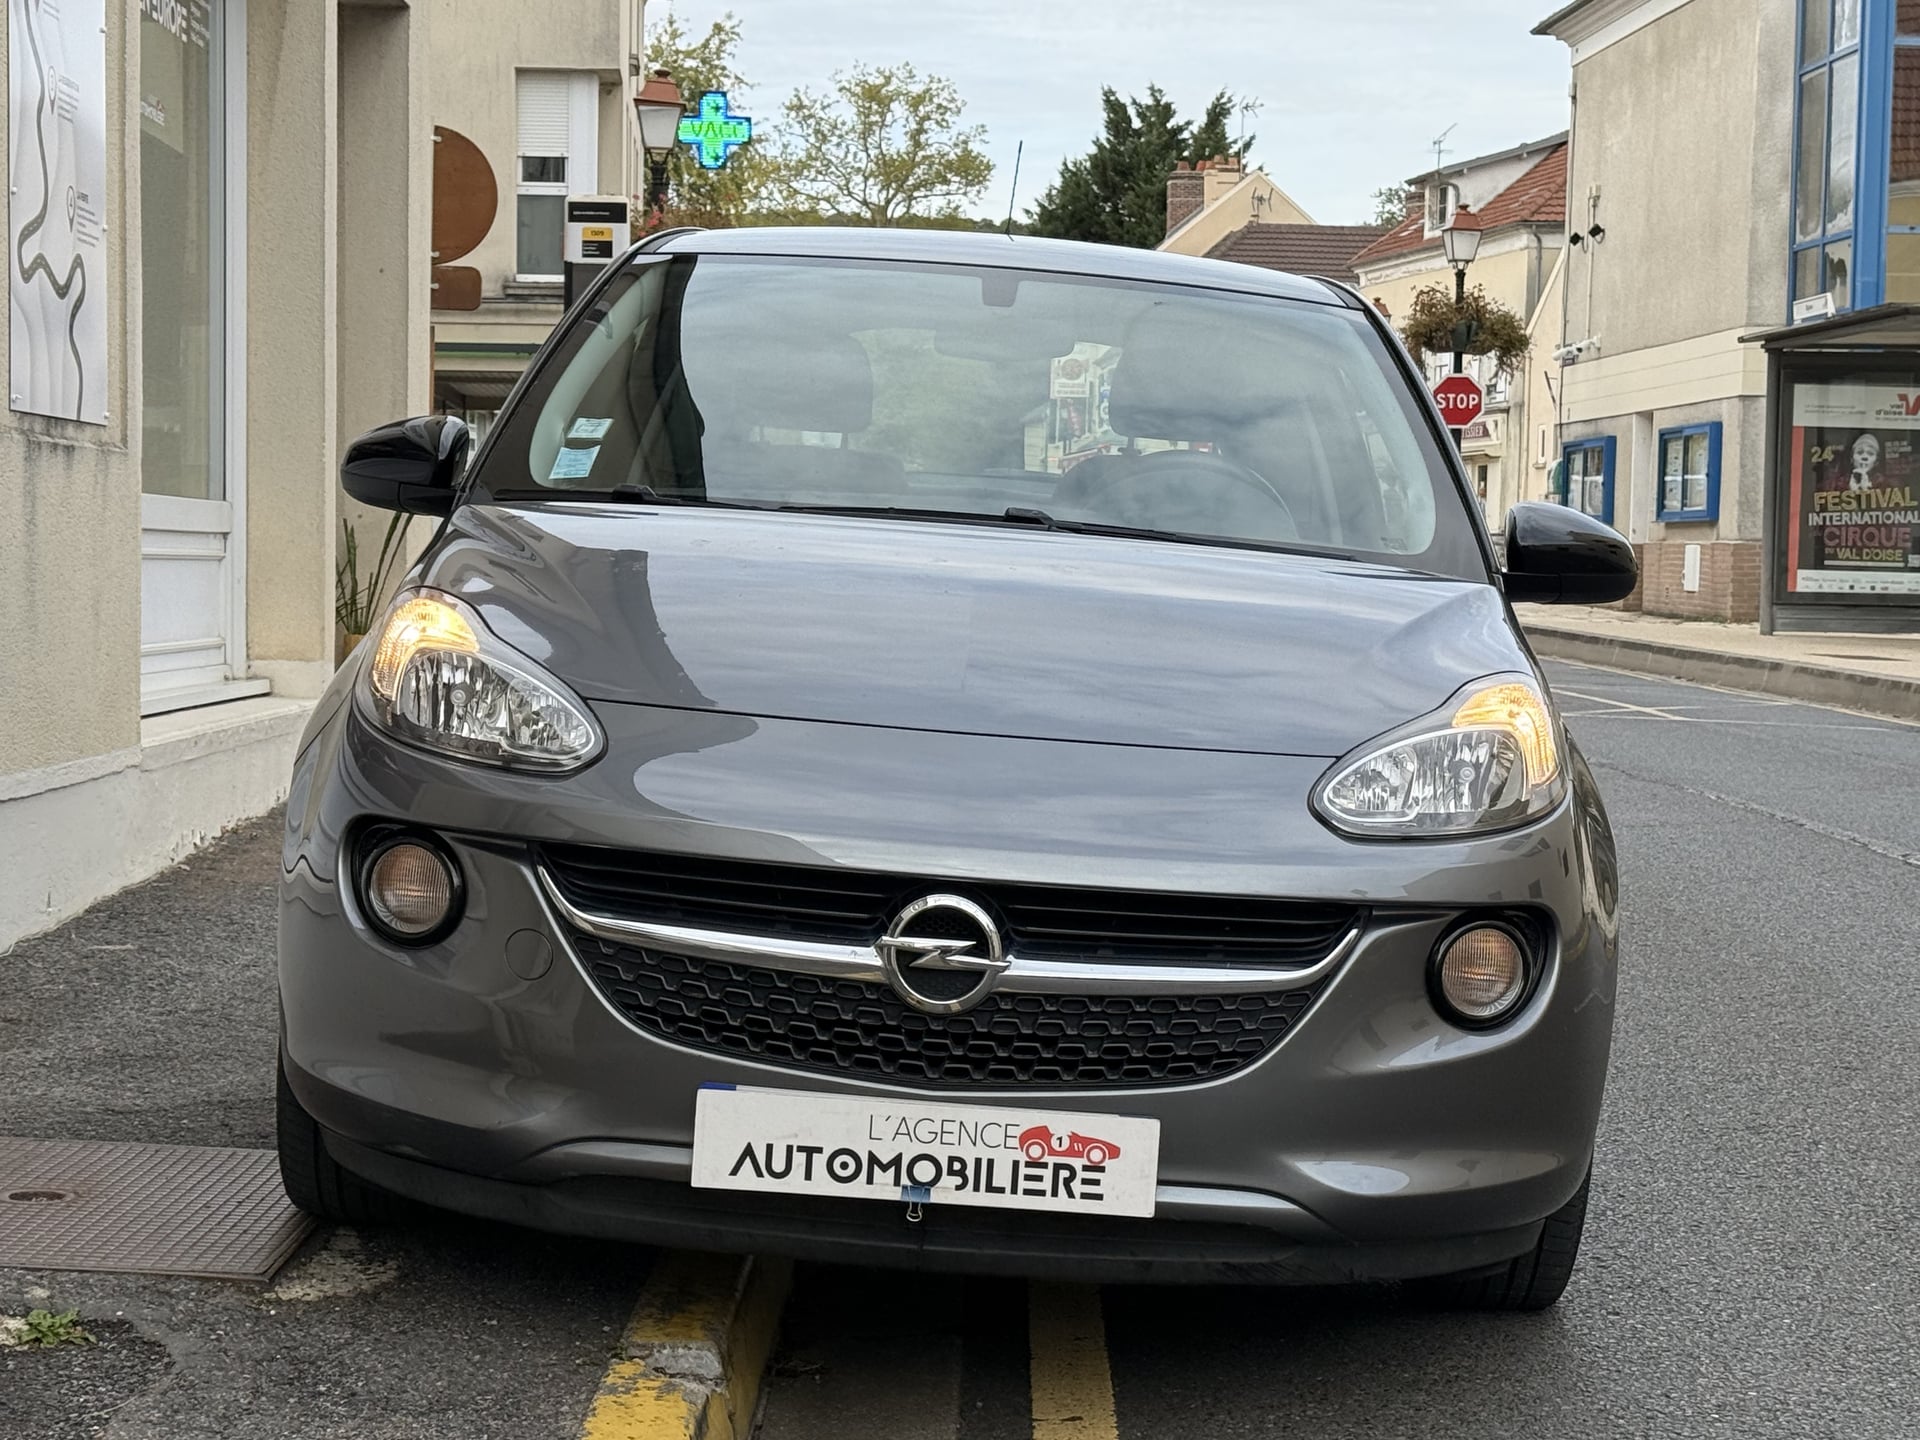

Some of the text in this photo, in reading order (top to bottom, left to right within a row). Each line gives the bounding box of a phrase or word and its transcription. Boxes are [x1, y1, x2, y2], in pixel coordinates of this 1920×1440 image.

[1436, 393, 1479, 409] STOP
[1813, 486, 1918, 512] FESTIVAL
[1808, 510, 1920, 526] INTERNATIONAL
[1823, 526, 1912, 548] CIRQUE
[1836, 547, 1860, 560] VAL
[1862, 548, 1904, 561] D'OISE
[868, 1113, 1020, 1150] L'AGENCE
[1056, 1135, 1063, 1148] 1
[728, 1141, 1106, 1201] AUTOMOBILIERE
